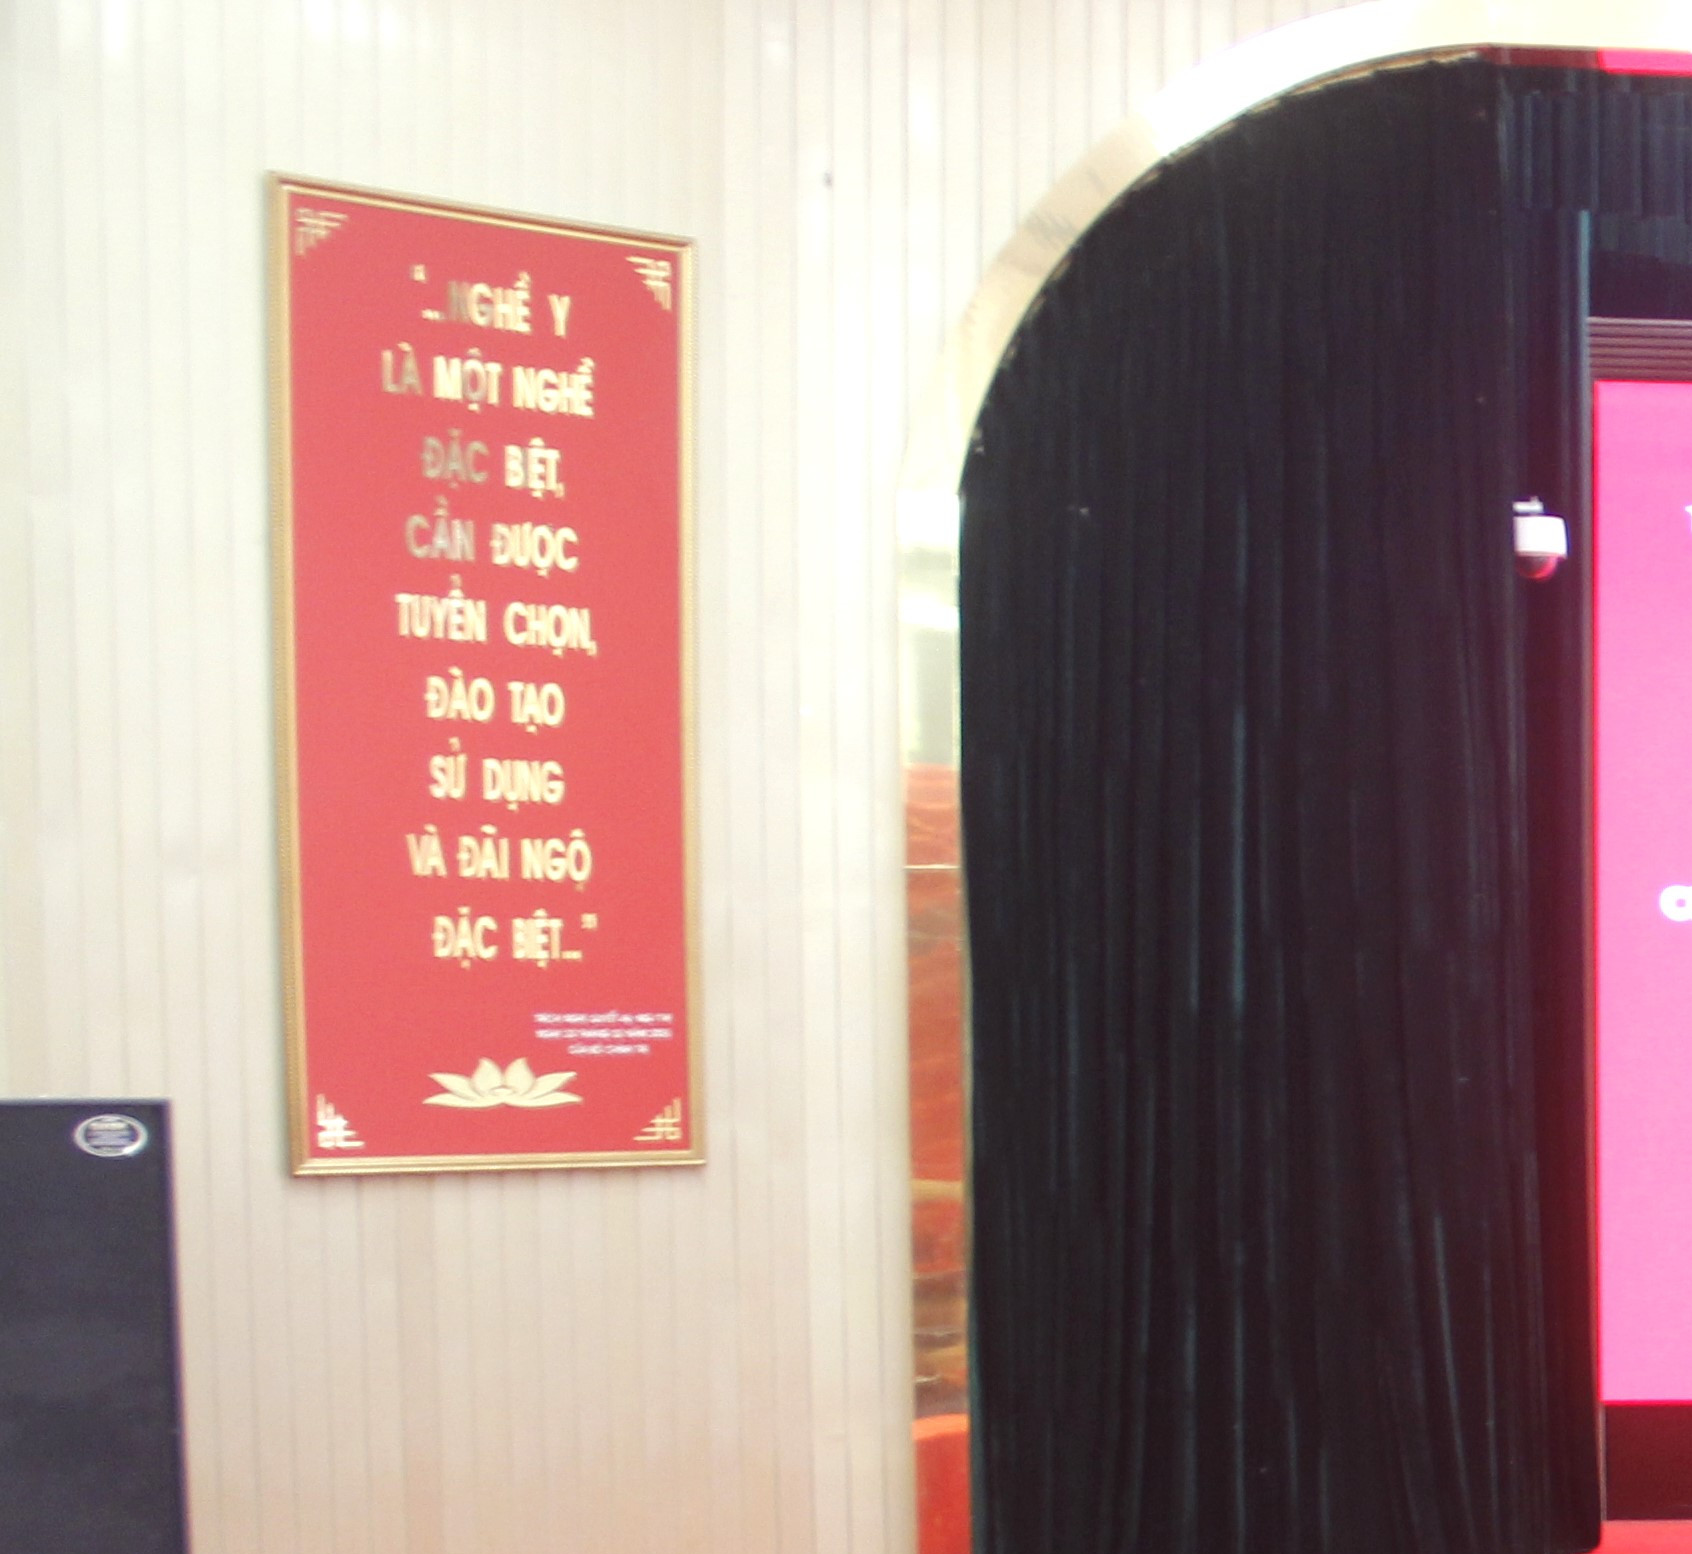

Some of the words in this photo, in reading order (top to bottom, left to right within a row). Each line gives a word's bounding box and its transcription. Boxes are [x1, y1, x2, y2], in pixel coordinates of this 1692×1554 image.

[548, 294, 574, 340] Y
[382, 342, 425, 396] LÀ
[433, 348, 504, 414] MỘT
[511, 358, 598, 420] NGHỀ
[421, 429, 490, 490] ĐẶC
[406, 496, 477, 564] CẦN
[490, 522, 581, 580] ĐƯỢC
[394, 574, 490, 646] TUYỂN
[503, 602, 600, 660] CHỌN,
[424, 667, 498, 725] ĐÀO
[507, 682, 568, 736] TẠO
[429, 737, 470, 802] SỬ
[482, 759, 568, 813] DỤNG
[406, 824, 449, 879] VÀ
[519, 829, 595, 893] NGỘ
[432, 907, 500, 971] ĐẶC
